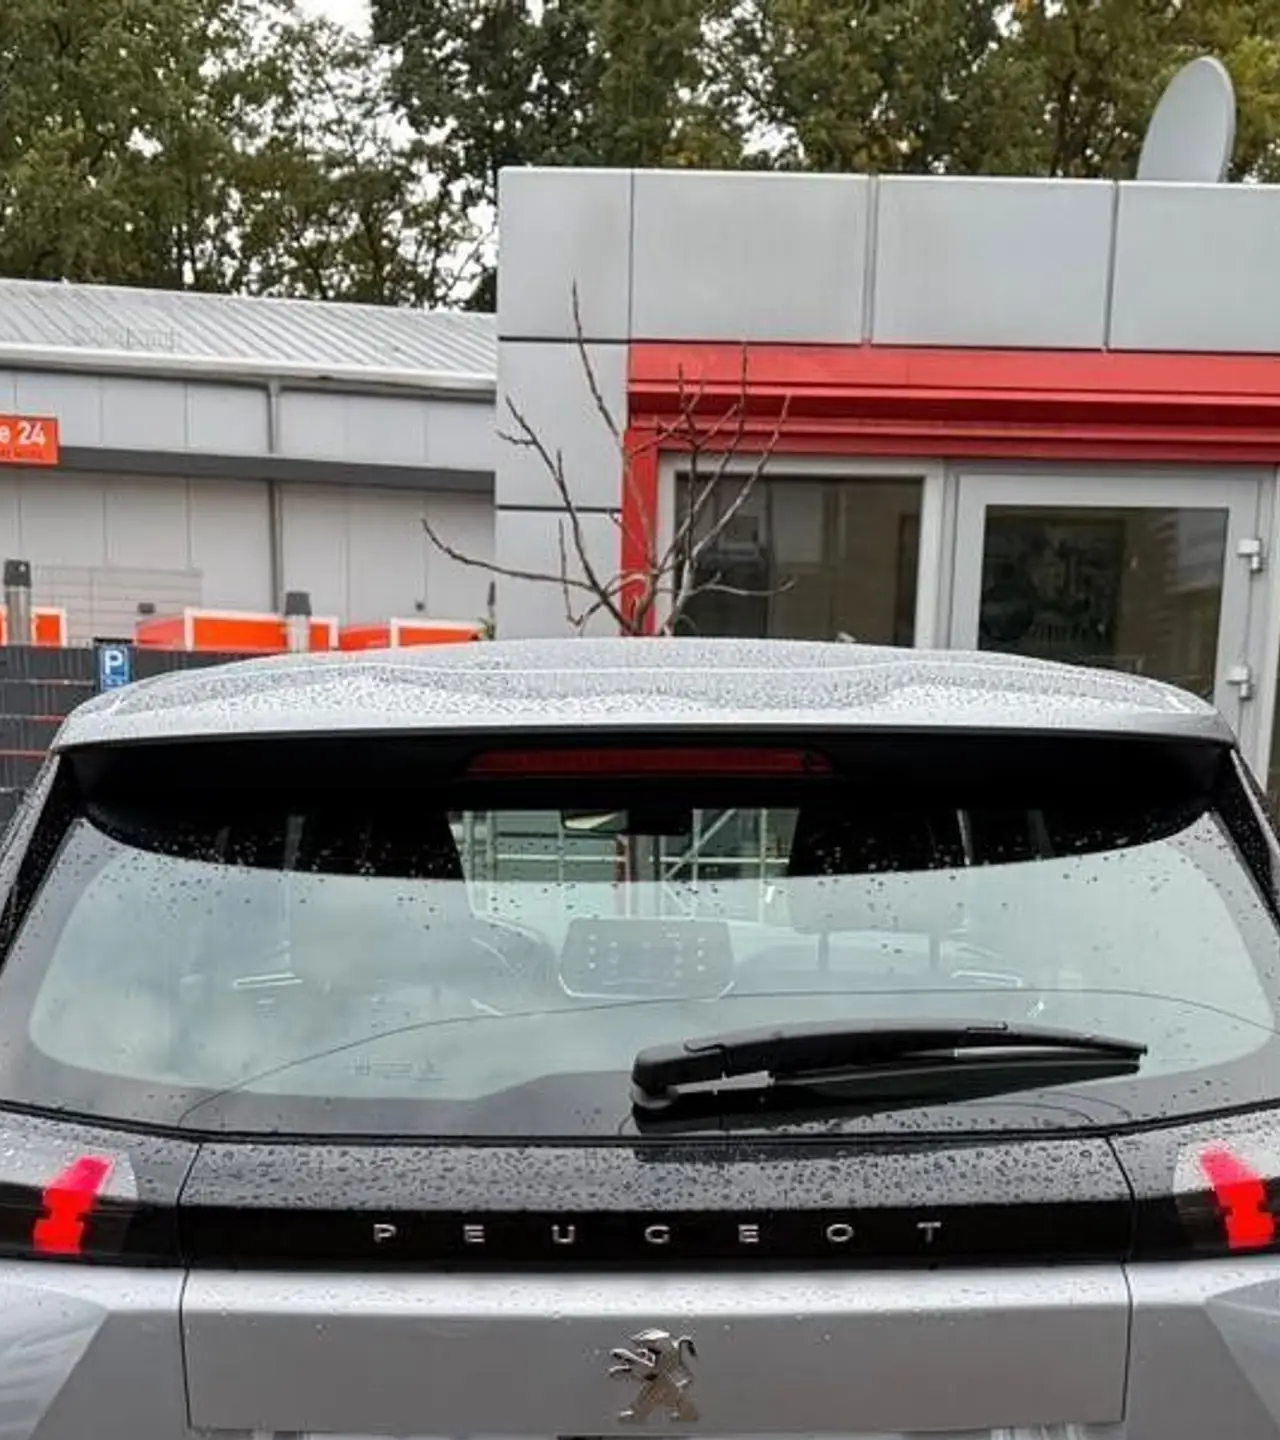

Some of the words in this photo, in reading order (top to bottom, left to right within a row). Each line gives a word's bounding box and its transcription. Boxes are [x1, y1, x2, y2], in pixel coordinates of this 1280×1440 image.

[17, 420, 46, 445] 24
[105, 650, 123, 675] P
[373, 1221, 942, 1244] PEUGEOT
